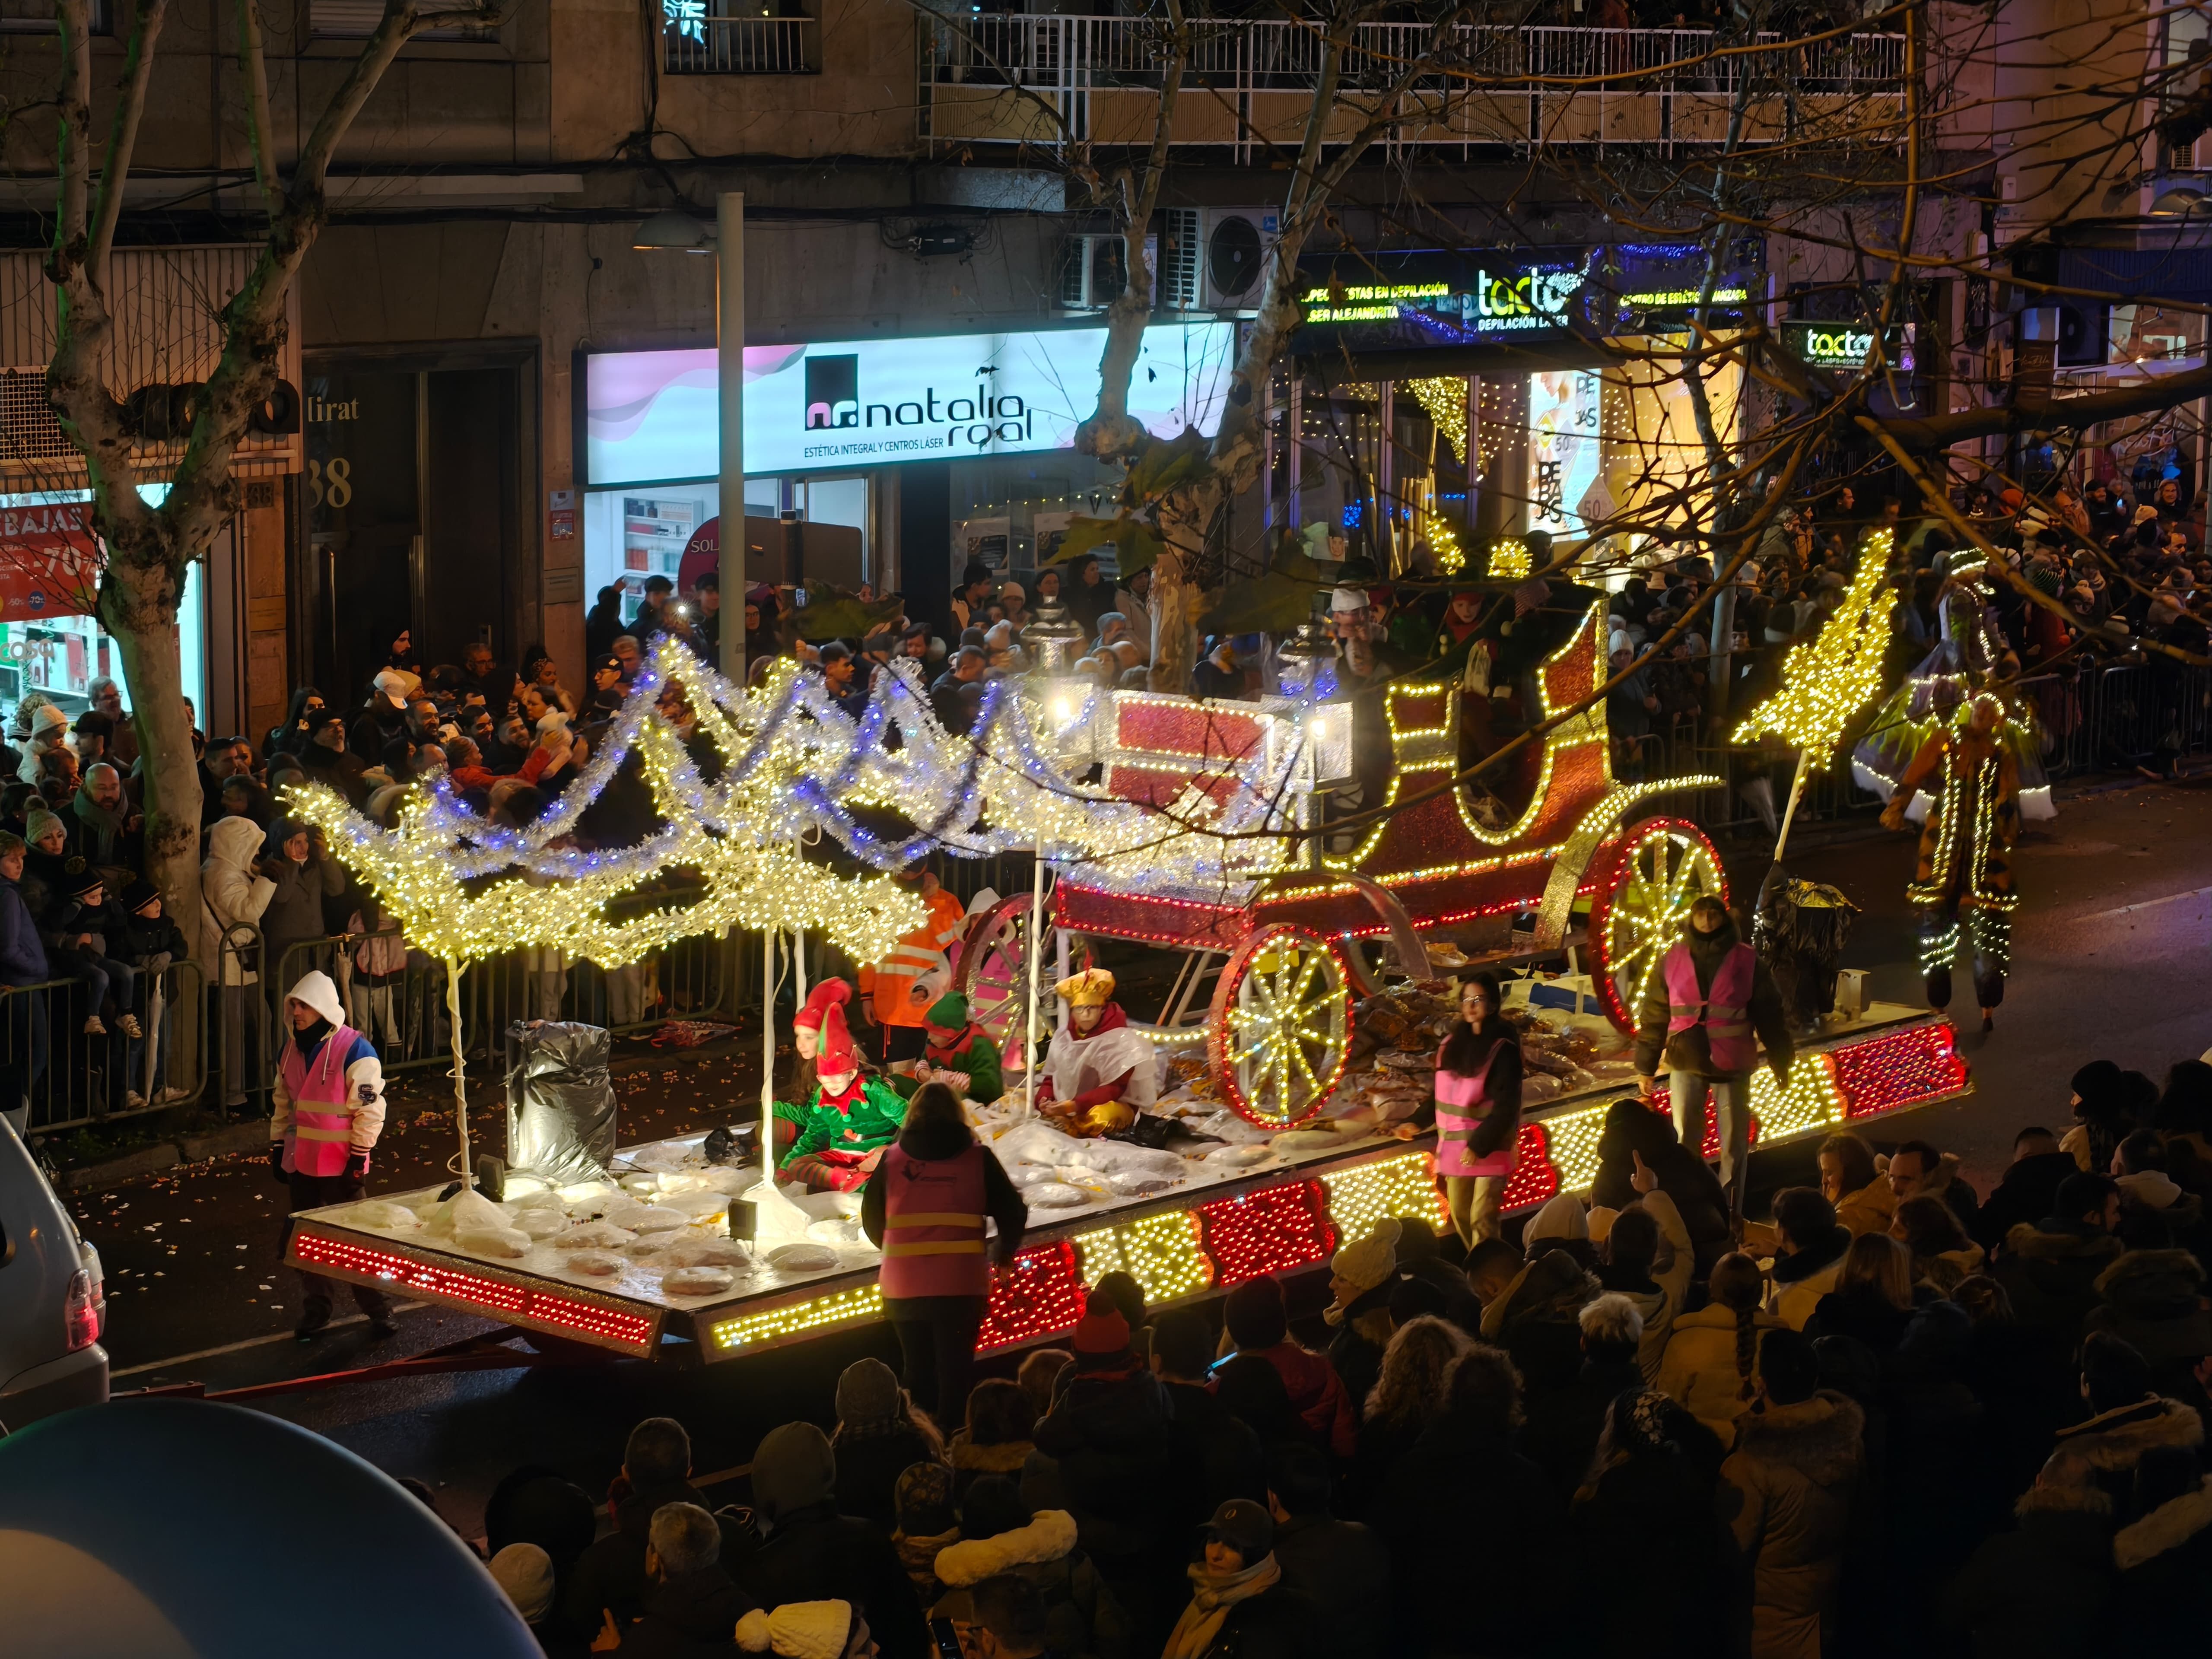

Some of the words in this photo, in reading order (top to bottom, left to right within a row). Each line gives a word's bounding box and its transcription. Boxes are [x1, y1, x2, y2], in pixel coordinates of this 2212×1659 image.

[1301, 286, 1373, 302] PECSTAS
[1375, 285, 1389, 299] EN
[1390, 281, 1449, 298] DEPILACIÓN
[1655, 292, 1667, 305] DE
[1668, 289, 1701, 305] ESTÉTIC
[1712, 289, 1748, 302] ANZADA
[1307, 308, 1330, 323] SER
[1332, 305, 1399, 321] ALEJANDRITA
[1478, 315, 1536, 332] DEPILACIÓN
[1538, 315, 1569, 329] LER
[1807, 329, 1874, 357] tacto
[866, 384, 1024, 428] natalia
[804, 440, 839, 458] ESTÉTICA
[841, 439, 877, 455] INTEGRAL
[877, 442, 884, 452] Y
[884, 435, 918, 451] CENTROS
[920, 432, 944, 448] LÁSER
[0, 507, 82, 537] BAJAS
[691, 539, 719, 553] SOL
